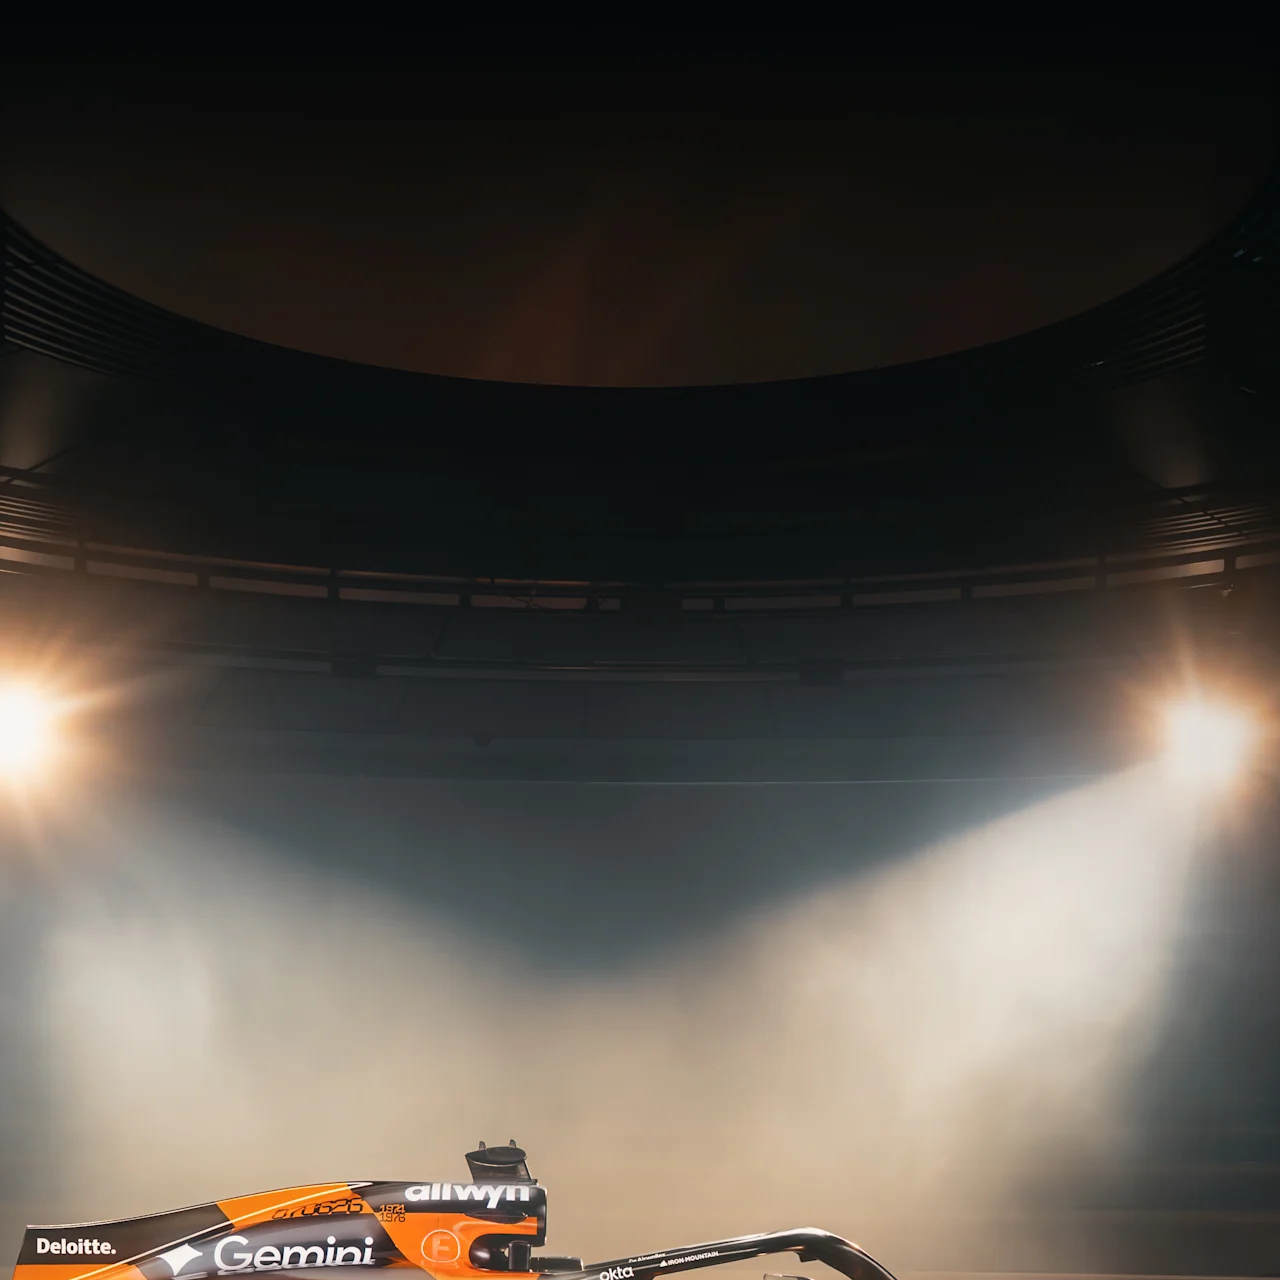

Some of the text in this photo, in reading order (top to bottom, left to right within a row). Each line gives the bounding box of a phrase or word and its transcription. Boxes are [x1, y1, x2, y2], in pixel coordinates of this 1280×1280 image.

[404, 1182, 530, 1208] allwyn
[36, 1237, 117, 1255] Deloitte.
[213, 1234, 374, 1270] Gemini
[667, 1250, 719, 1266] IRON MOUNTAIN
